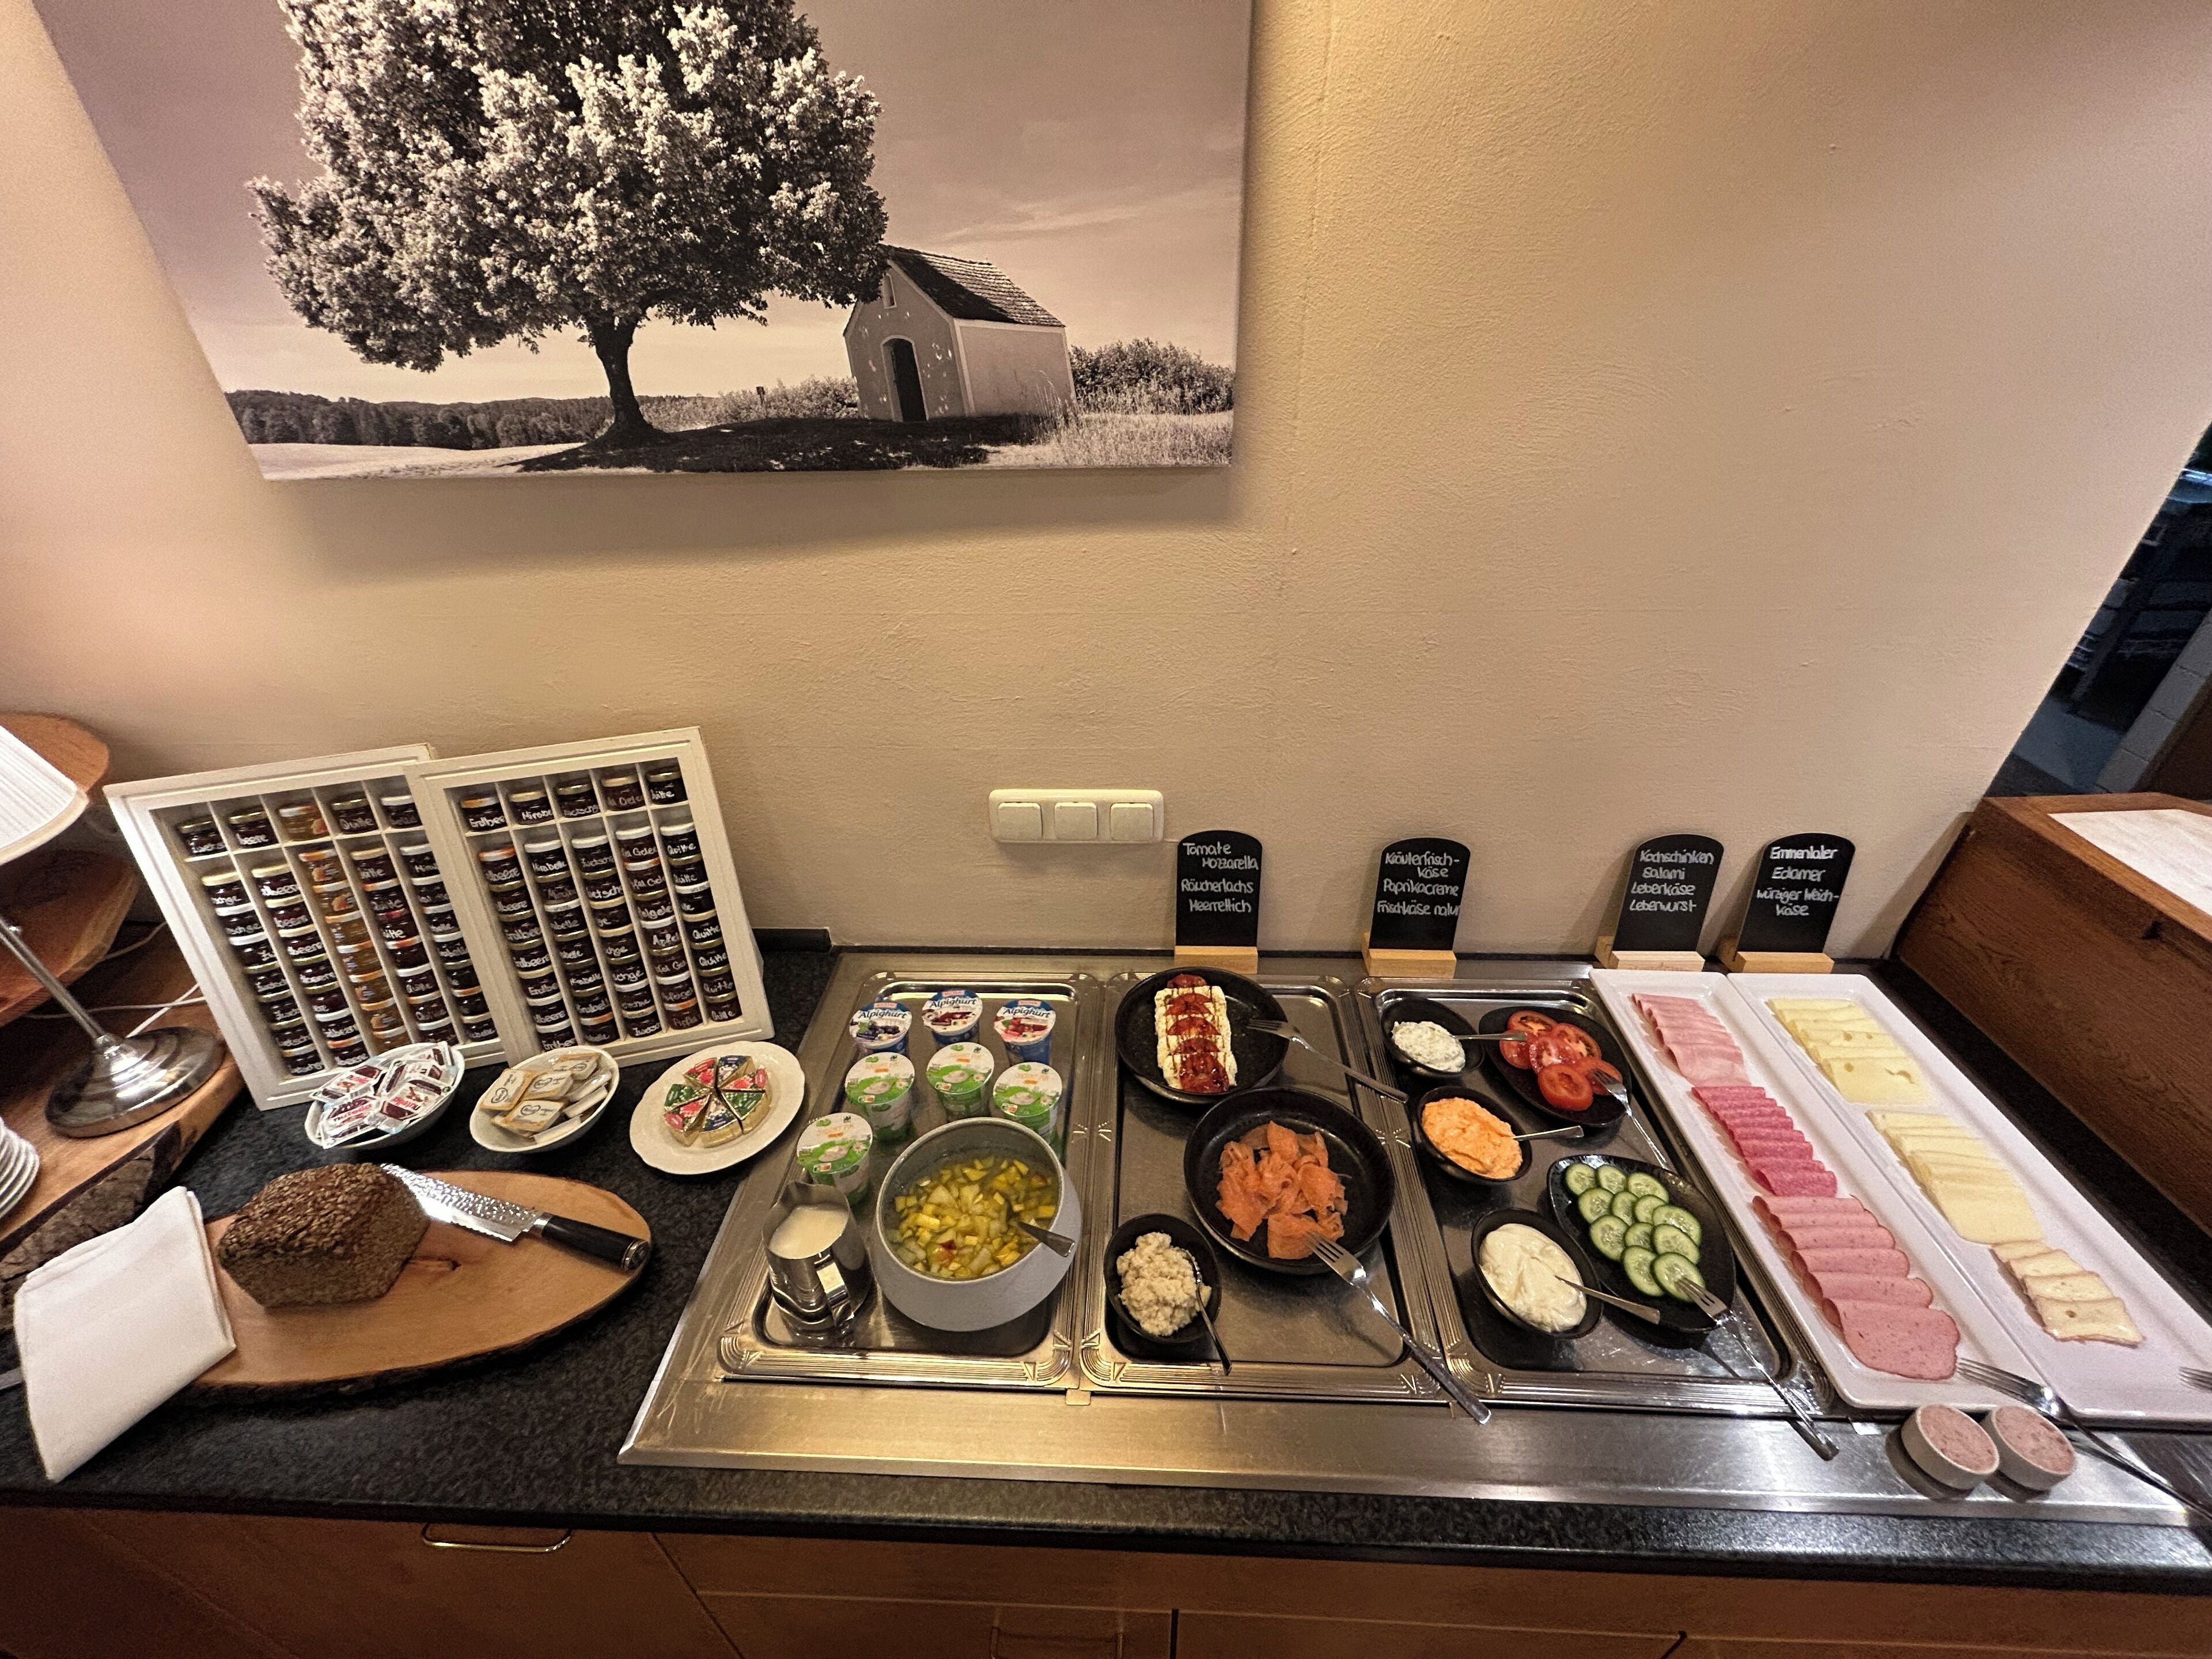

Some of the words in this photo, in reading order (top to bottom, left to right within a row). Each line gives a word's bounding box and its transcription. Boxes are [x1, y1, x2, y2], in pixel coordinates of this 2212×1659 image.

[1183, 841, 1231, 855] Tomate
[1202, 855, 1259, 870] Mozzarella
[1639, 849, 1714, 865] Kochschinken
[1642, 866, 1685, 880] Salami
[1771, 866, 1826, 882] Edamer
[1181, 878, 1253, 893] Räucherlachs
[1383, 878, 1459, 896] Paprikacreme
[1631, 881, 1696, 896] Leberkäse
[1189, 898, 1252, 912] Meerrettich
[1377, 900, 1431, 915] Frischkäse
[1434, 903, 1460, 916] natur
[1629, 899, 1697, 912] Leberwurst
[929, 998, 977, 1009] Alpighurt
[858, 1009, 908, 1019] Alpighurt
[1002, 1007, 1050, 1018] Alpighurt
